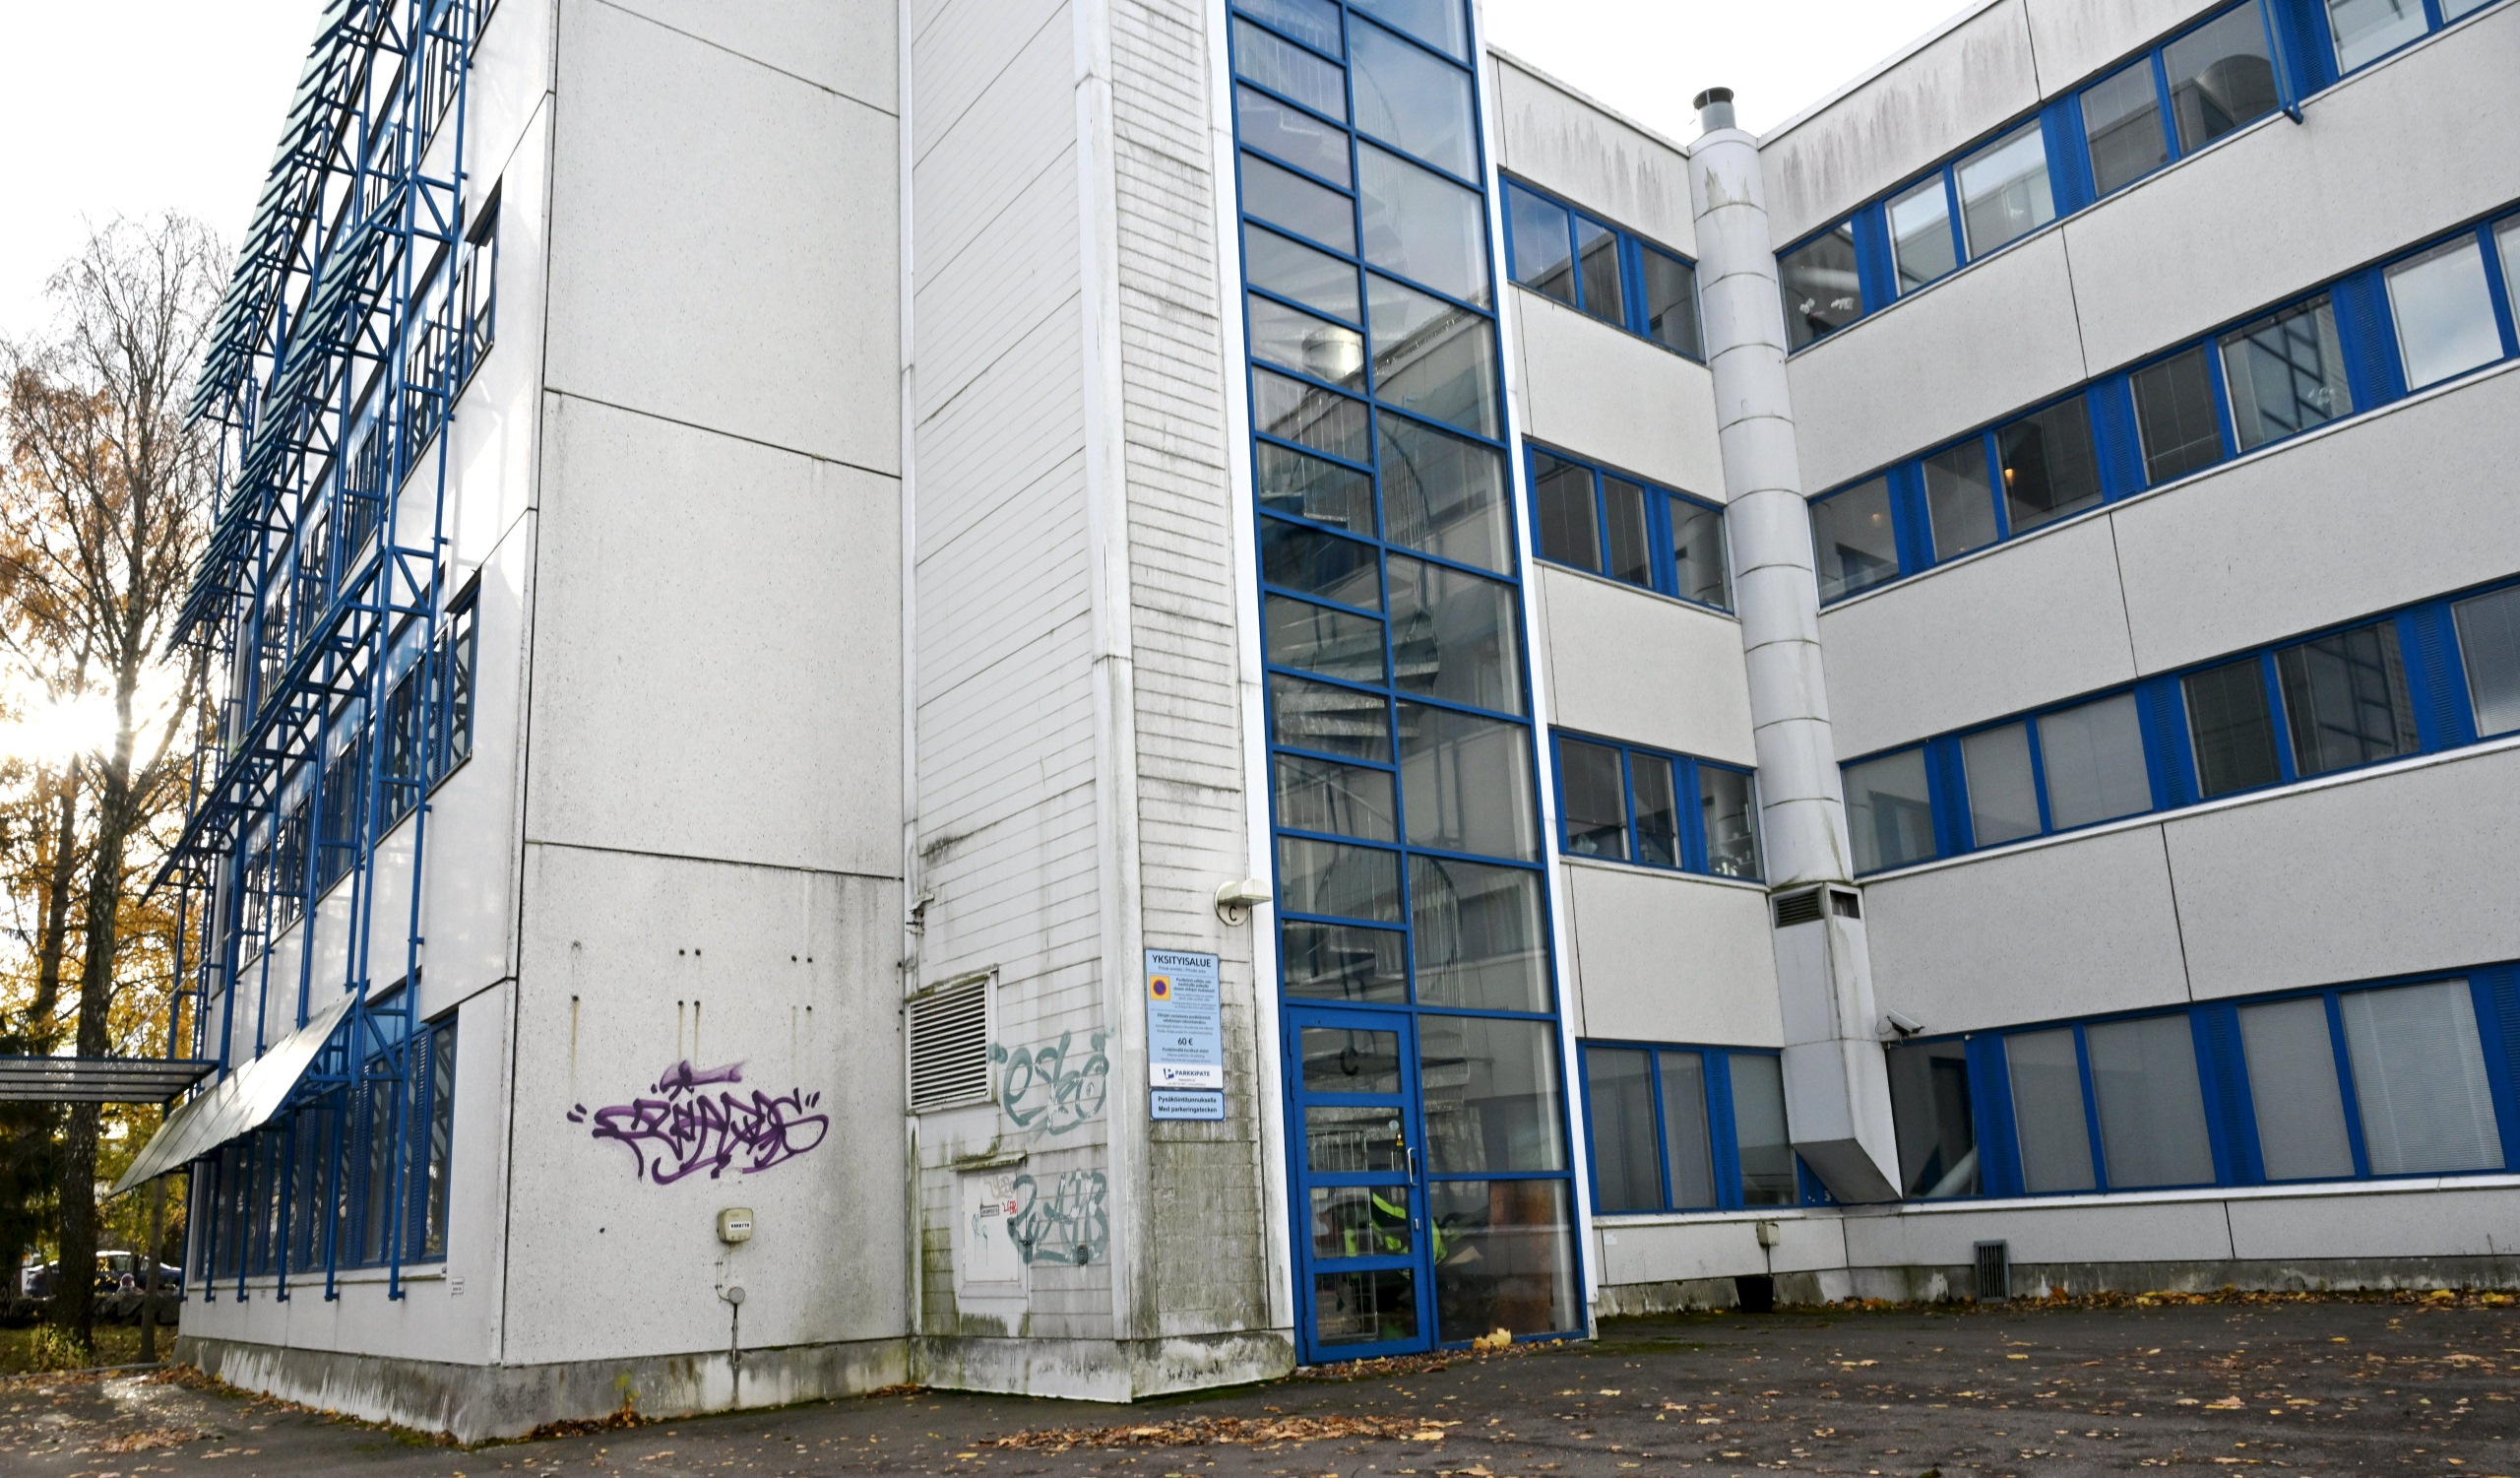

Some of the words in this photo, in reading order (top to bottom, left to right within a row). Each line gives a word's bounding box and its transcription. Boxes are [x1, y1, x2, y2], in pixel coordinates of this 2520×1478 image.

[1228, 905, 1237, 922] C
[1152, 954, 1212, 968] YKSITYISALUE
[1177, 1037, 1187, 1046] 60
[1188, 1037, 1194, 1046] €
[1158, 1095, 1217, 1104] Pysäköintitunnuksella
